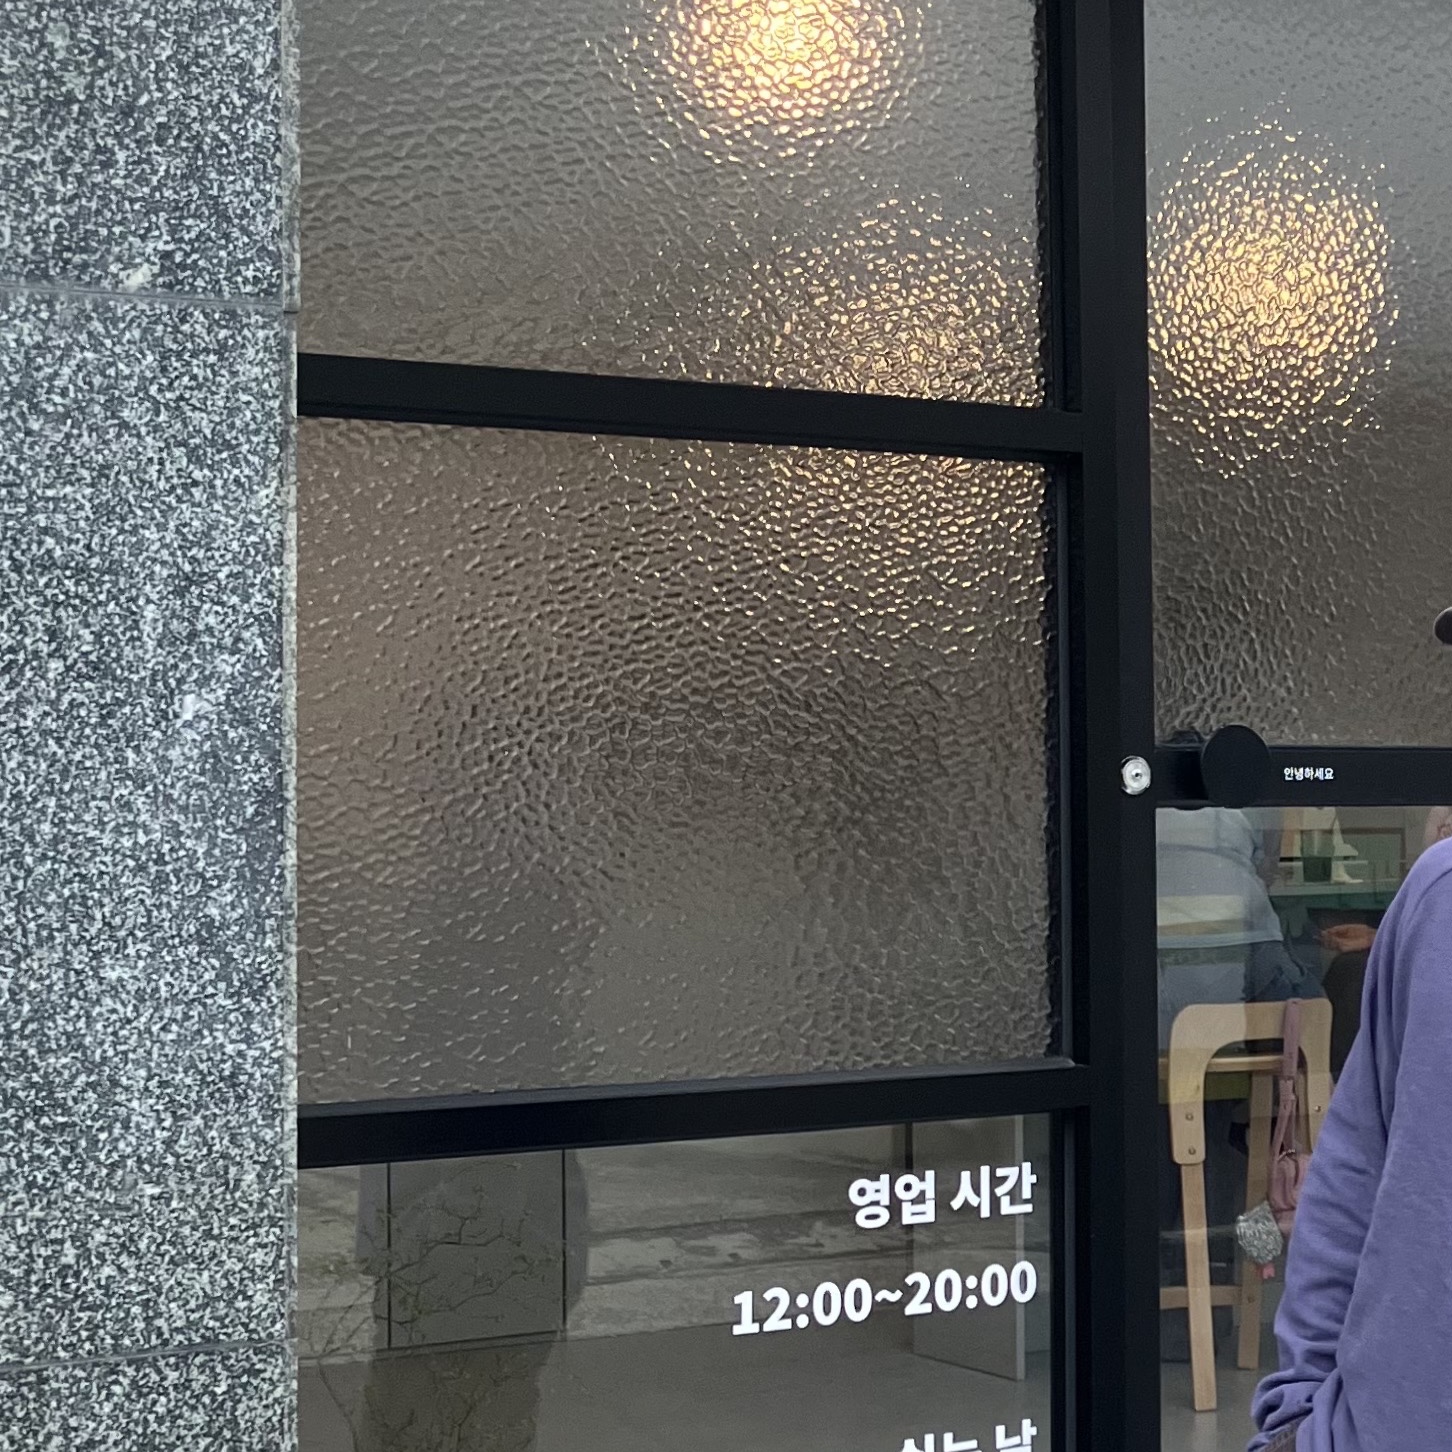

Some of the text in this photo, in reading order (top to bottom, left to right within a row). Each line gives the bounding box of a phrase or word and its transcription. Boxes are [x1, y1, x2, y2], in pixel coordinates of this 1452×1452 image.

[1283, 766, 1334, 781] 안녕하세요
[848, 1161, 1037, 1229] 영업 시간
[732, 1260, 1037, 1336] 12:00~20:00
